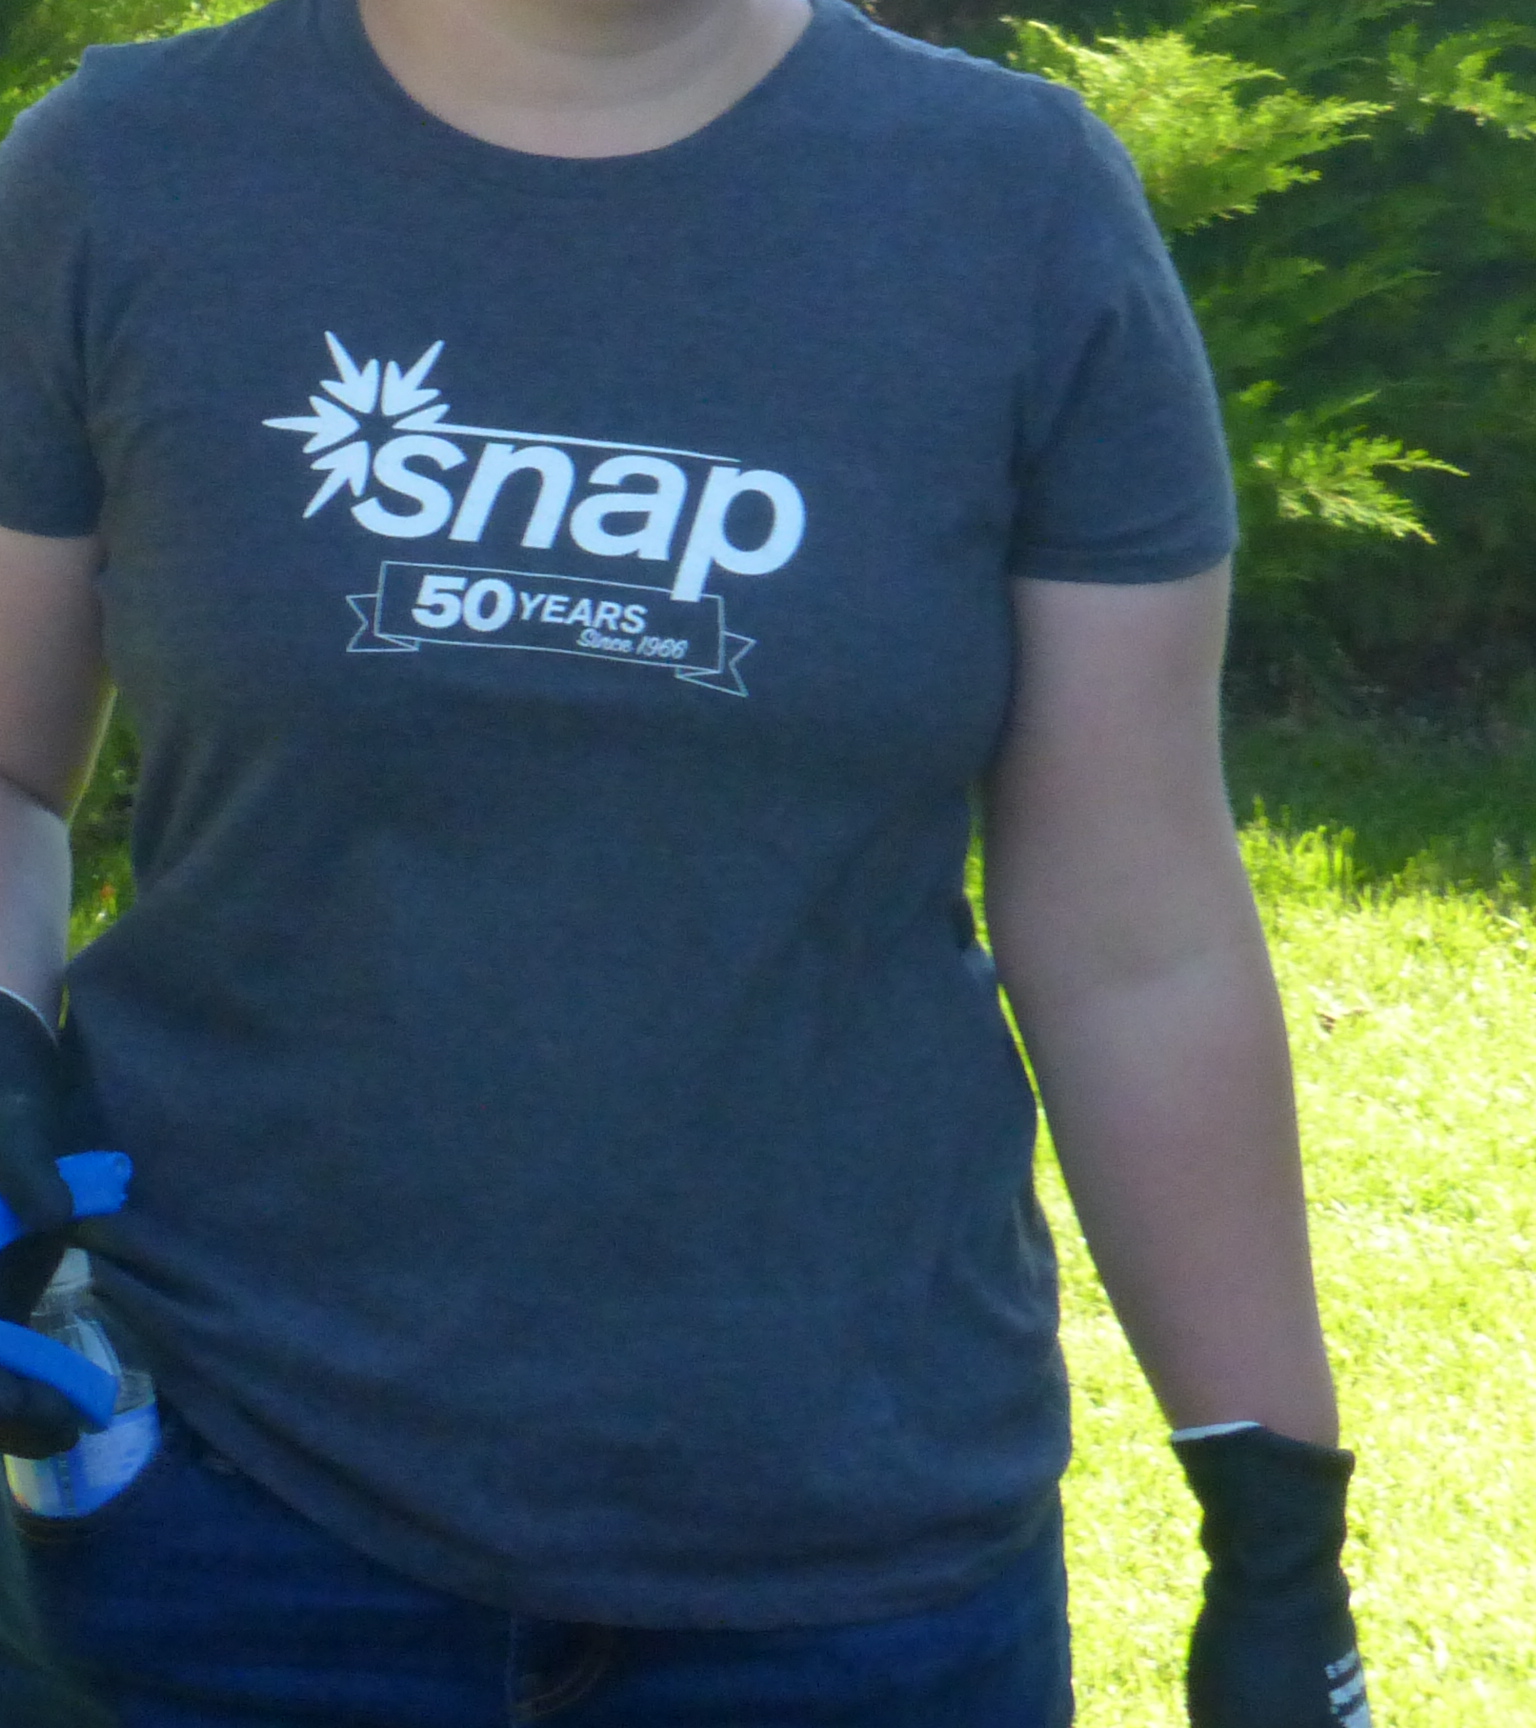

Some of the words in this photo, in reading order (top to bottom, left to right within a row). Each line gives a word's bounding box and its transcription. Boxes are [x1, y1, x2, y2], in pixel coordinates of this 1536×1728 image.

[350, 434, 807, 603] snap
[411, 574, 515, 633] 50
[517, 591, 648, 635] YEARS
[575, 627, 634, 653] Since
[635, 635, 689, 660] 1966
